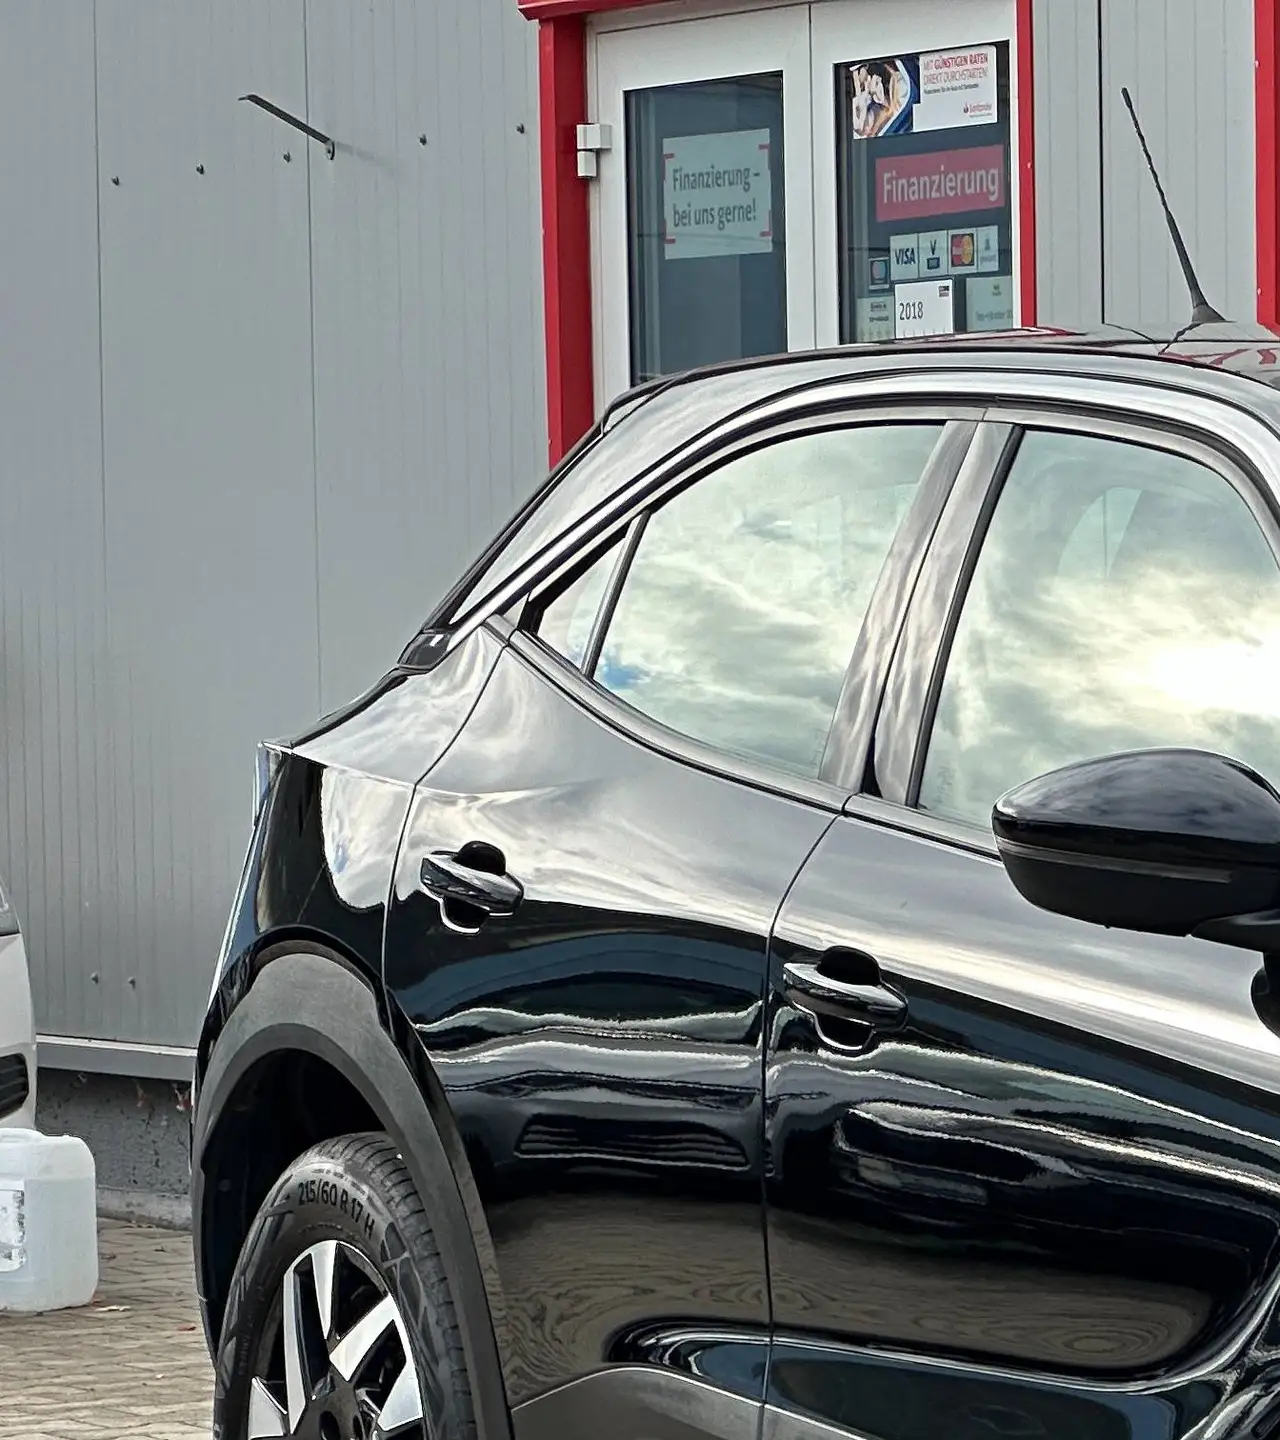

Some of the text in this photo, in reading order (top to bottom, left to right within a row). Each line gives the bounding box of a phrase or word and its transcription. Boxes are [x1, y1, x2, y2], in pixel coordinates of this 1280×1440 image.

[672, 164, 751, 192] Finanzierung
[883, 164, 999, 204] Finanzierung
[673, 198, 756, 231] bei uns gerne!
[895, 248, 916, 265] VISA
[900, 301, 924, 321] 2018
[298, 1179, 337, 1206] 215/60
[340, 1189, 349, 1214] R
[351, 1198, 364, 1223] 17
